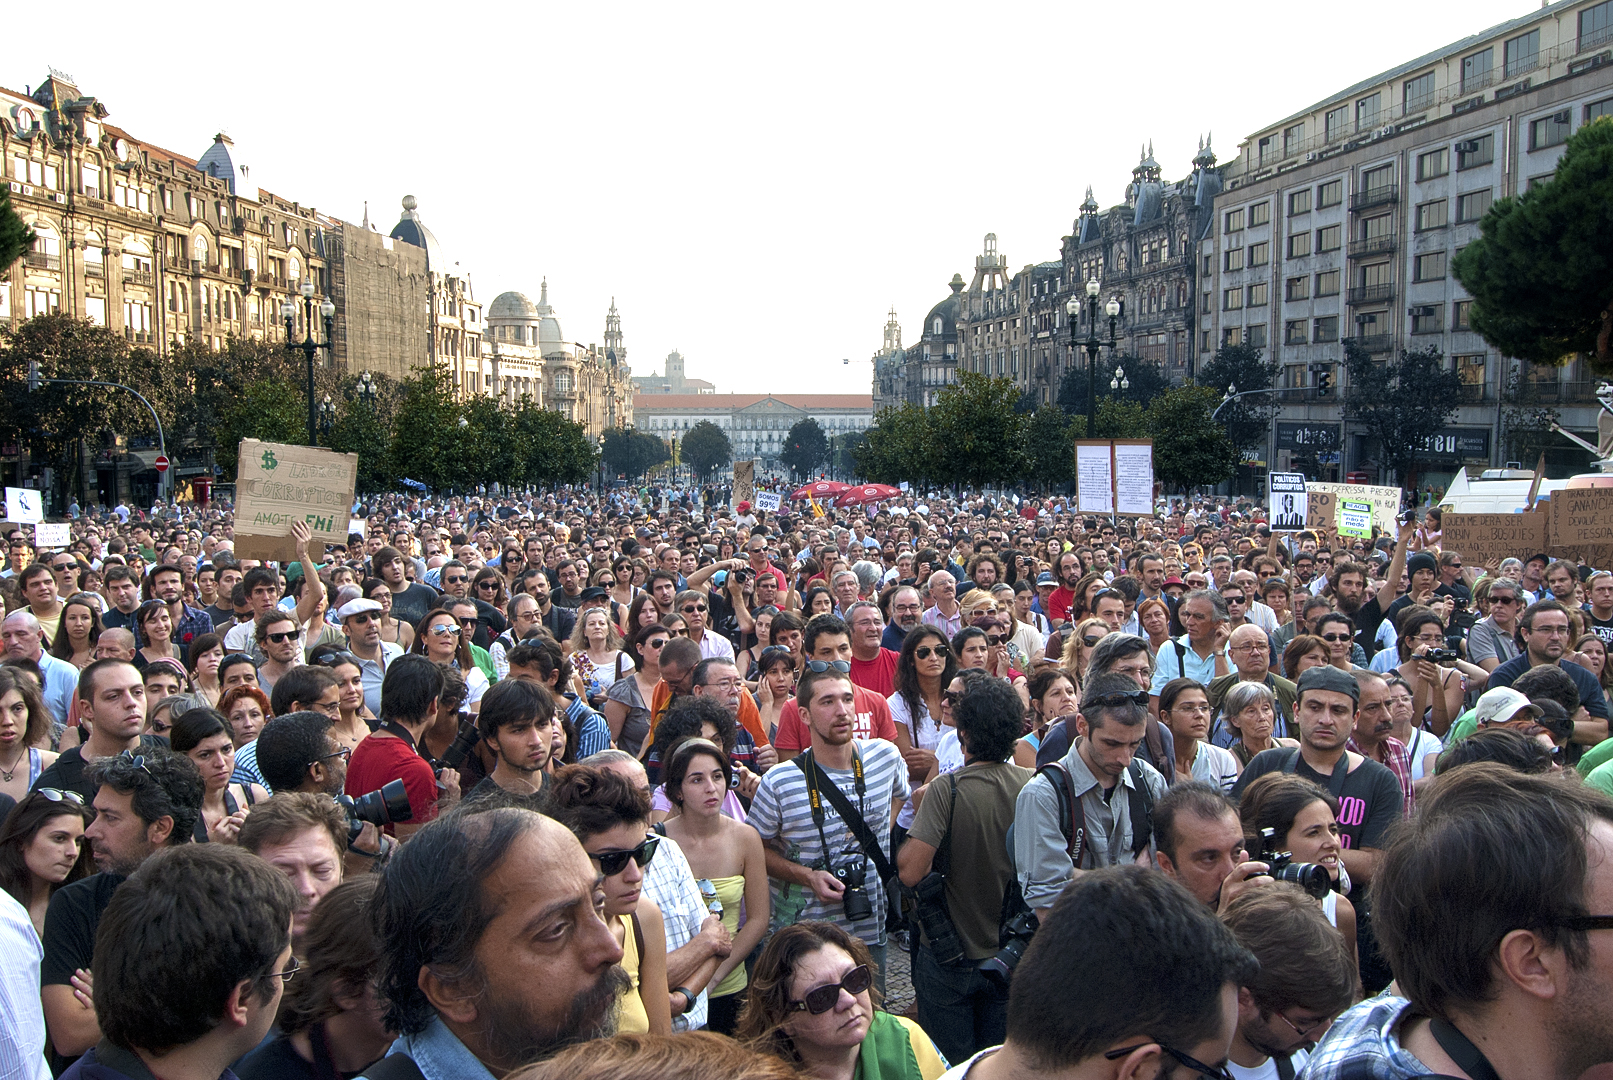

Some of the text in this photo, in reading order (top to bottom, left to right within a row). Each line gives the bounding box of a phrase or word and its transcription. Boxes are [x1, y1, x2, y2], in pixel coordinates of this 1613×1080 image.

[1273, 475, 1300, 483] POLÍTICOS
[247, 478, 347, 506] CORRUPTOS
[1272, 483, 1304, 491] CORRUPTOS
[1370, 487, 1398, 498] PRESOS
[758, 494, 779, 502] SOMOS
[1307, 493, 1329, 506] RO
[759, 500, 776, 509] 99%
[253, 511, 296, 526] AMO-TE
[1306, 515, 1327, 527] IZ
[1444, 516, 1523, 527] QUEM ME DERA SER
[1445, 528, 1470, 540] ROBIN
[1491, 528, 1535, 541] BOSQUES
[811, 789, 820, 808] Nikon
[1072, 827, 1084, 860] Canon
